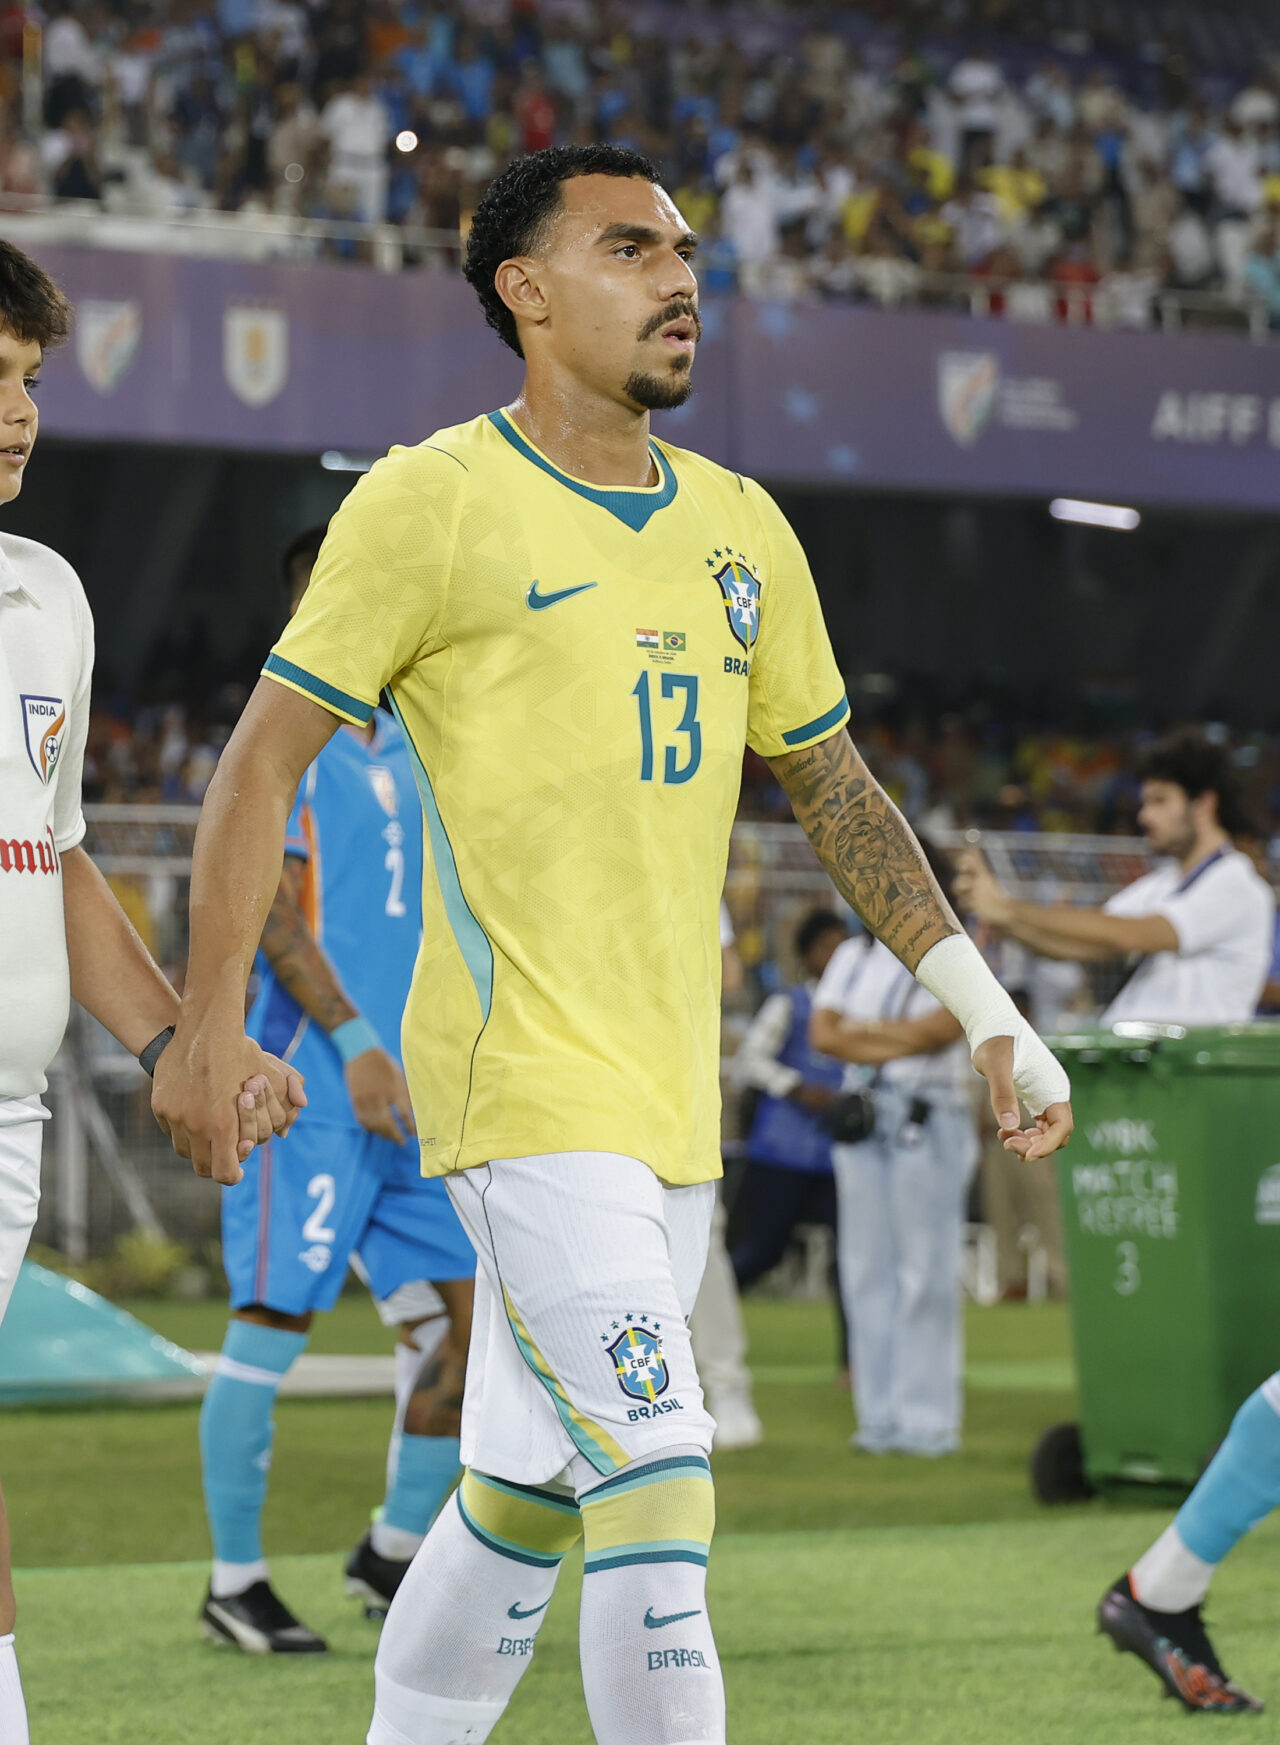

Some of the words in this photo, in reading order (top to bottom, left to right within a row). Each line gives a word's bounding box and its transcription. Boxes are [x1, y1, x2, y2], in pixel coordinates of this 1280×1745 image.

[1151, 388, 1261, 447] AIFF
[736, 596, 753, 609] CBF
[723, 656, 750, 677] BRA
[29, 703, 57, 718] INDIA
[631, 669, 702, 785] 13
[384, 847, 407, 918] 2
[1071, 1160, 1180, 1200] MATCH
[302, 1173, 336, 1243] 2
[1114, 1241, 1141, 1296] 3
[630, 1356, 651, 1369] CBF
[627, 1398, 684, 1422] BRASIL
[496, 1631, 537, 1656] BRA
[647, 1649, 712, 1672] BRASIL
